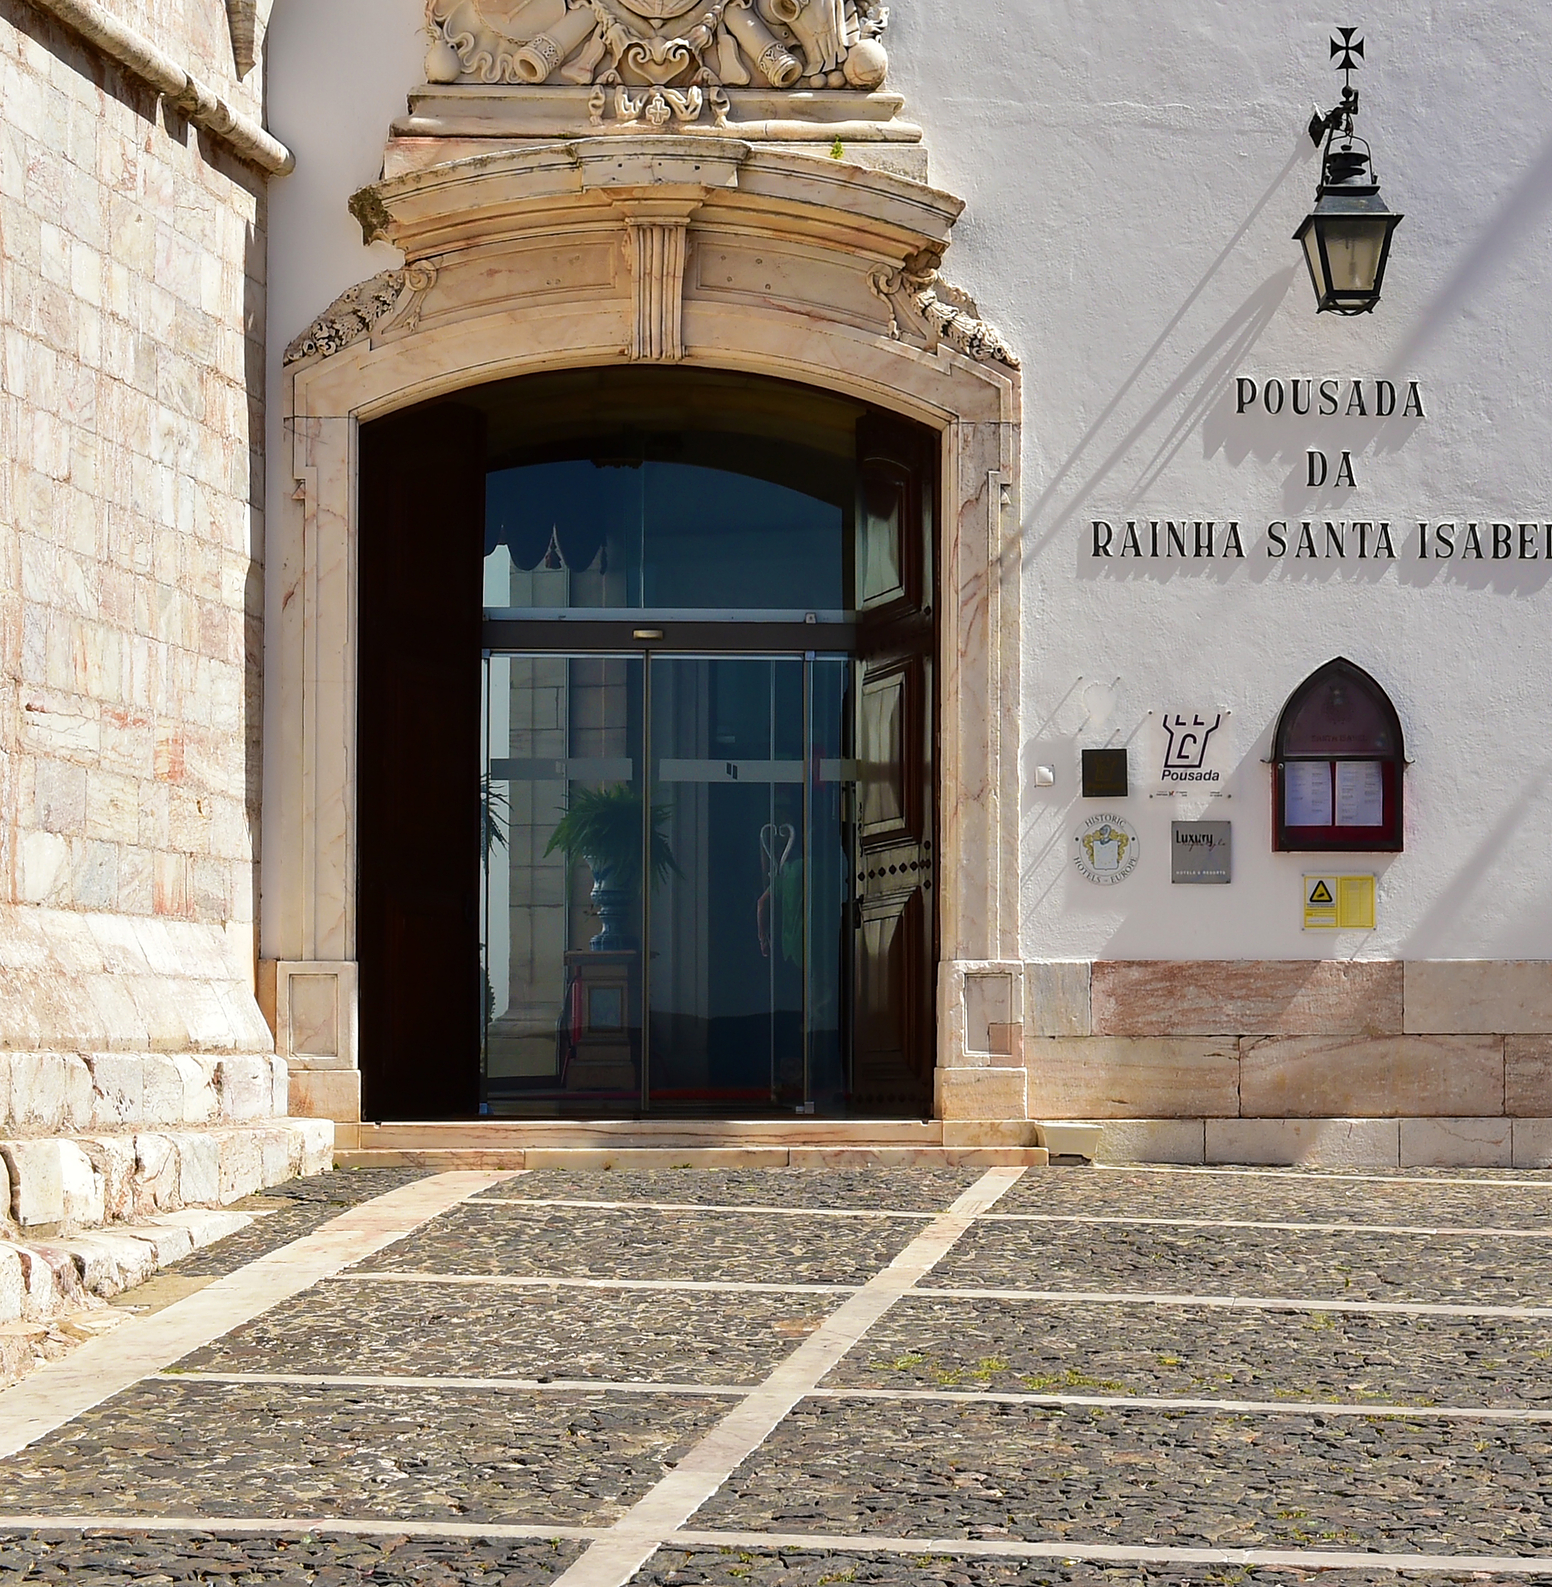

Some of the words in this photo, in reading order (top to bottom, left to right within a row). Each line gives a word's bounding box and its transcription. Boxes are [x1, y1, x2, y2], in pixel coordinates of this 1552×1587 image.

[1236, 377, 1425, 417] POUSADA
[1306, 451, 1357, 487] DA
[1091, 521, 1245, 557] RAINHA
[1267, 521, 1397, 559] SANTA
[1161, 769, 1220, 782] Pousada
[1085, 814, 1127, 828] HISTORIC
[1176, 830, 1213, 847] Luxury
[1073, 856, 1101, 883] HOTELS
[1110, 856, 1138, 883] EUROPE
